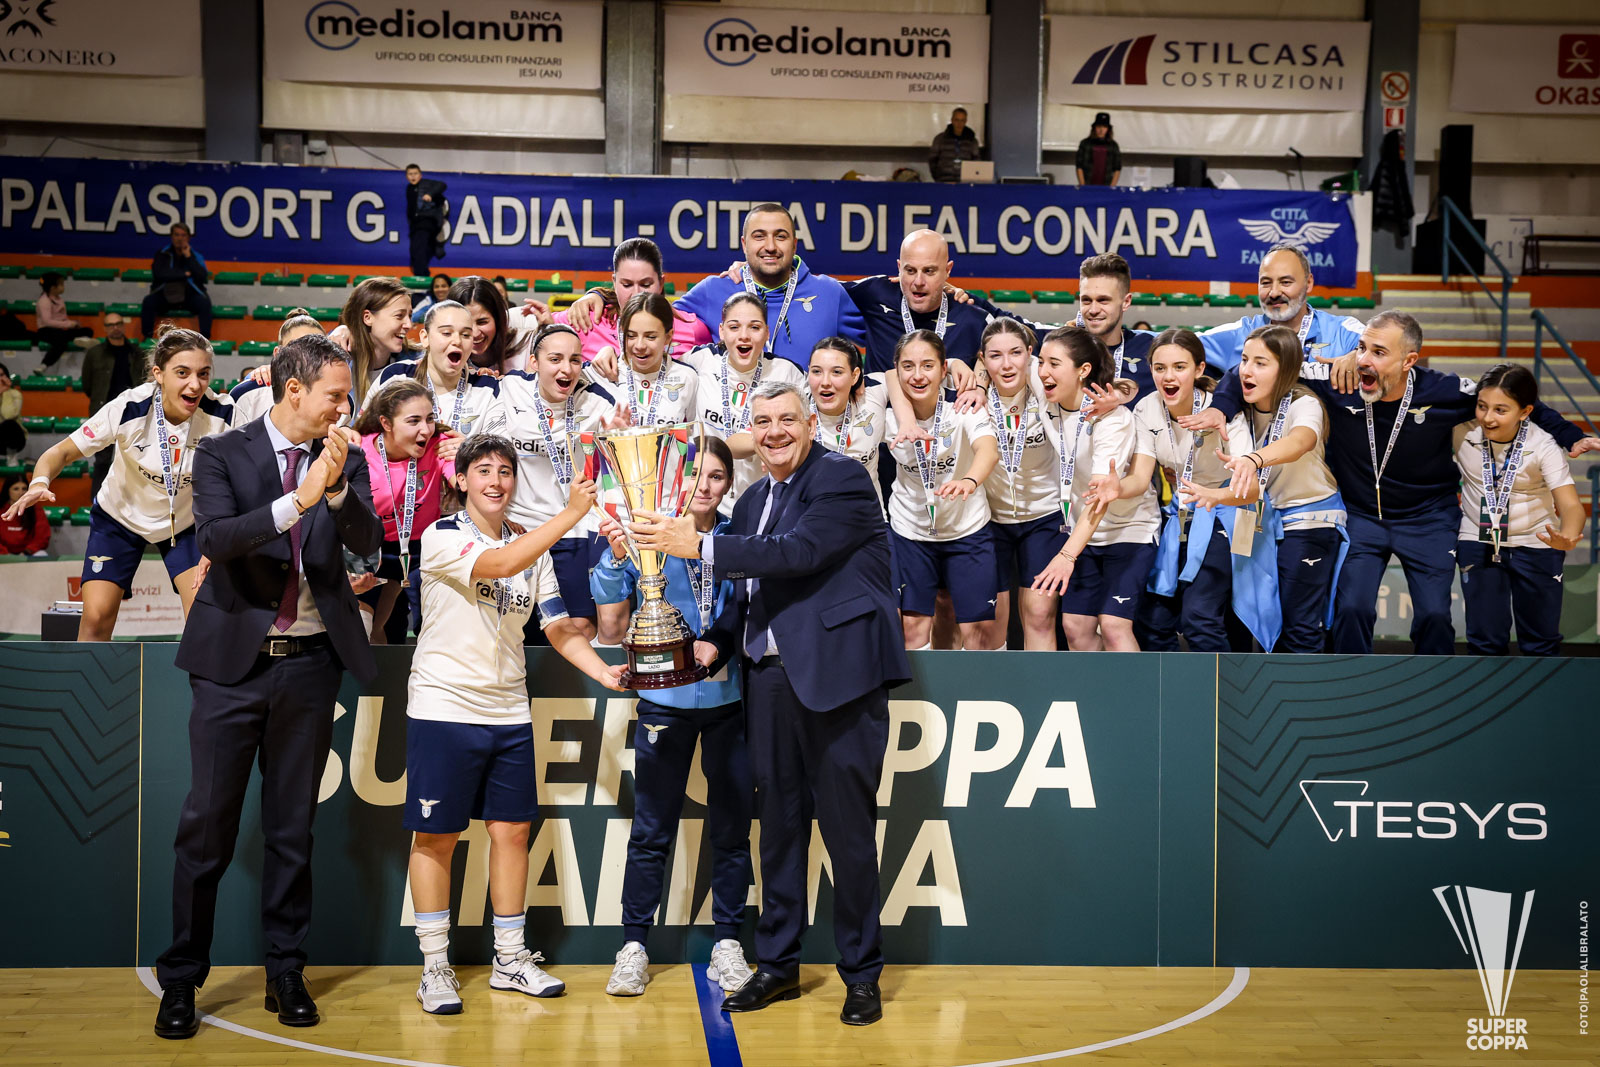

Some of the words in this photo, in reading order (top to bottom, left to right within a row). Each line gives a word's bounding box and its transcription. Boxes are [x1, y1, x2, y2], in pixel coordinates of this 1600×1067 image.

[511, 10, 562, 22] BANCA
[317, 8, 562, 43] mediolanum
[901, 27, 950, 37] BANCA
[716, 26, 951, 58] mediolanum
[375, 52, 415, 61] UFFICIO
[419, 53, 434, 62] DEI
[438, 53, 502, 64] CONSULENTI
[506, 56, 562, 66] FINANZIARI
[1163, 41, 1344, 67] STILCASA
[520, 68, 537, 78] JESI
[540, 69, 562, 79] (AN)
[771, 68, 809, 77] UFFICIO
[812, 68, 828, 77] DEI
[831, 69, 893, 79] CONSULENTI
[896, 71, 950, 80] FINANZIARI
[1162, 71, 1343, 90] COSTRUZIONI
[909, 84, 925, 92] JESI
[928, 84, 950, 93] (AN)
[1, 178, 333, 241] PALASPORT
[345, 190, 400, 244] G.
[441, 195, 624, 248] ADIALI
[668, 199, 826, 251] CITA'
[840, 203, 888, 252] DI
[1285, 221, 1296, 230] DI
[1333, 801, 1548, 840] TESYS
